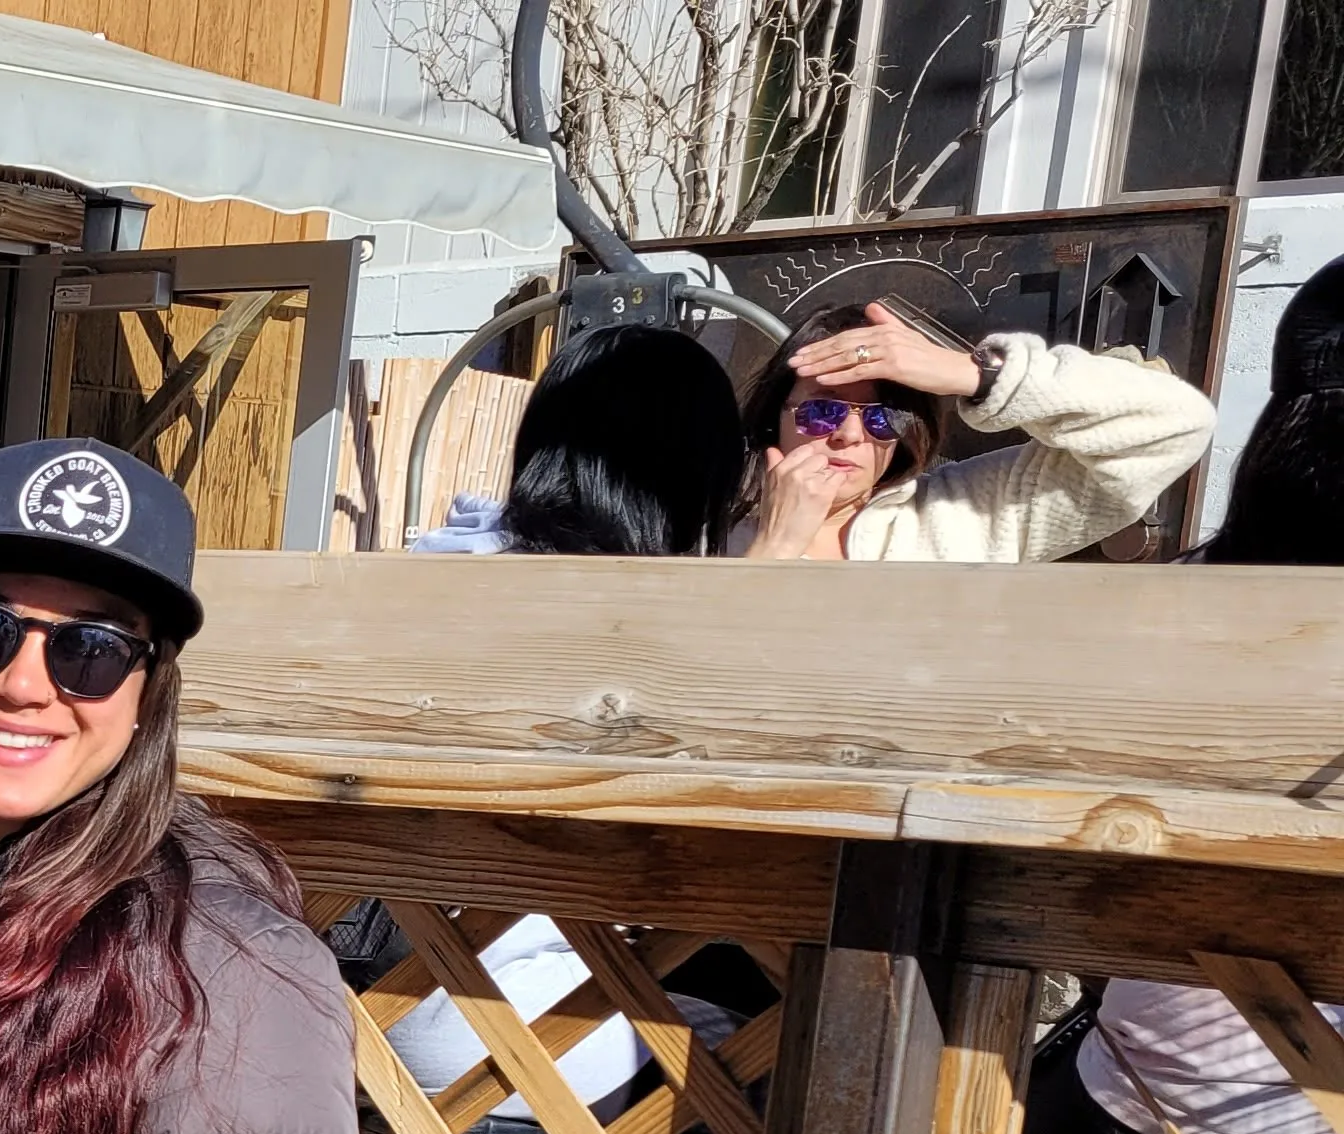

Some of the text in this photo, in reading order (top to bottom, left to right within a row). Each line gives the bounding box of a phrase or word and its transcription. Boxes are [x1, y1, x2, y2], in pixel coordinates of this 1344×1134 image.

[612, 296, 625, 313] 3
[27, 459, 123, 528] CROOKED GOAT BREWING
